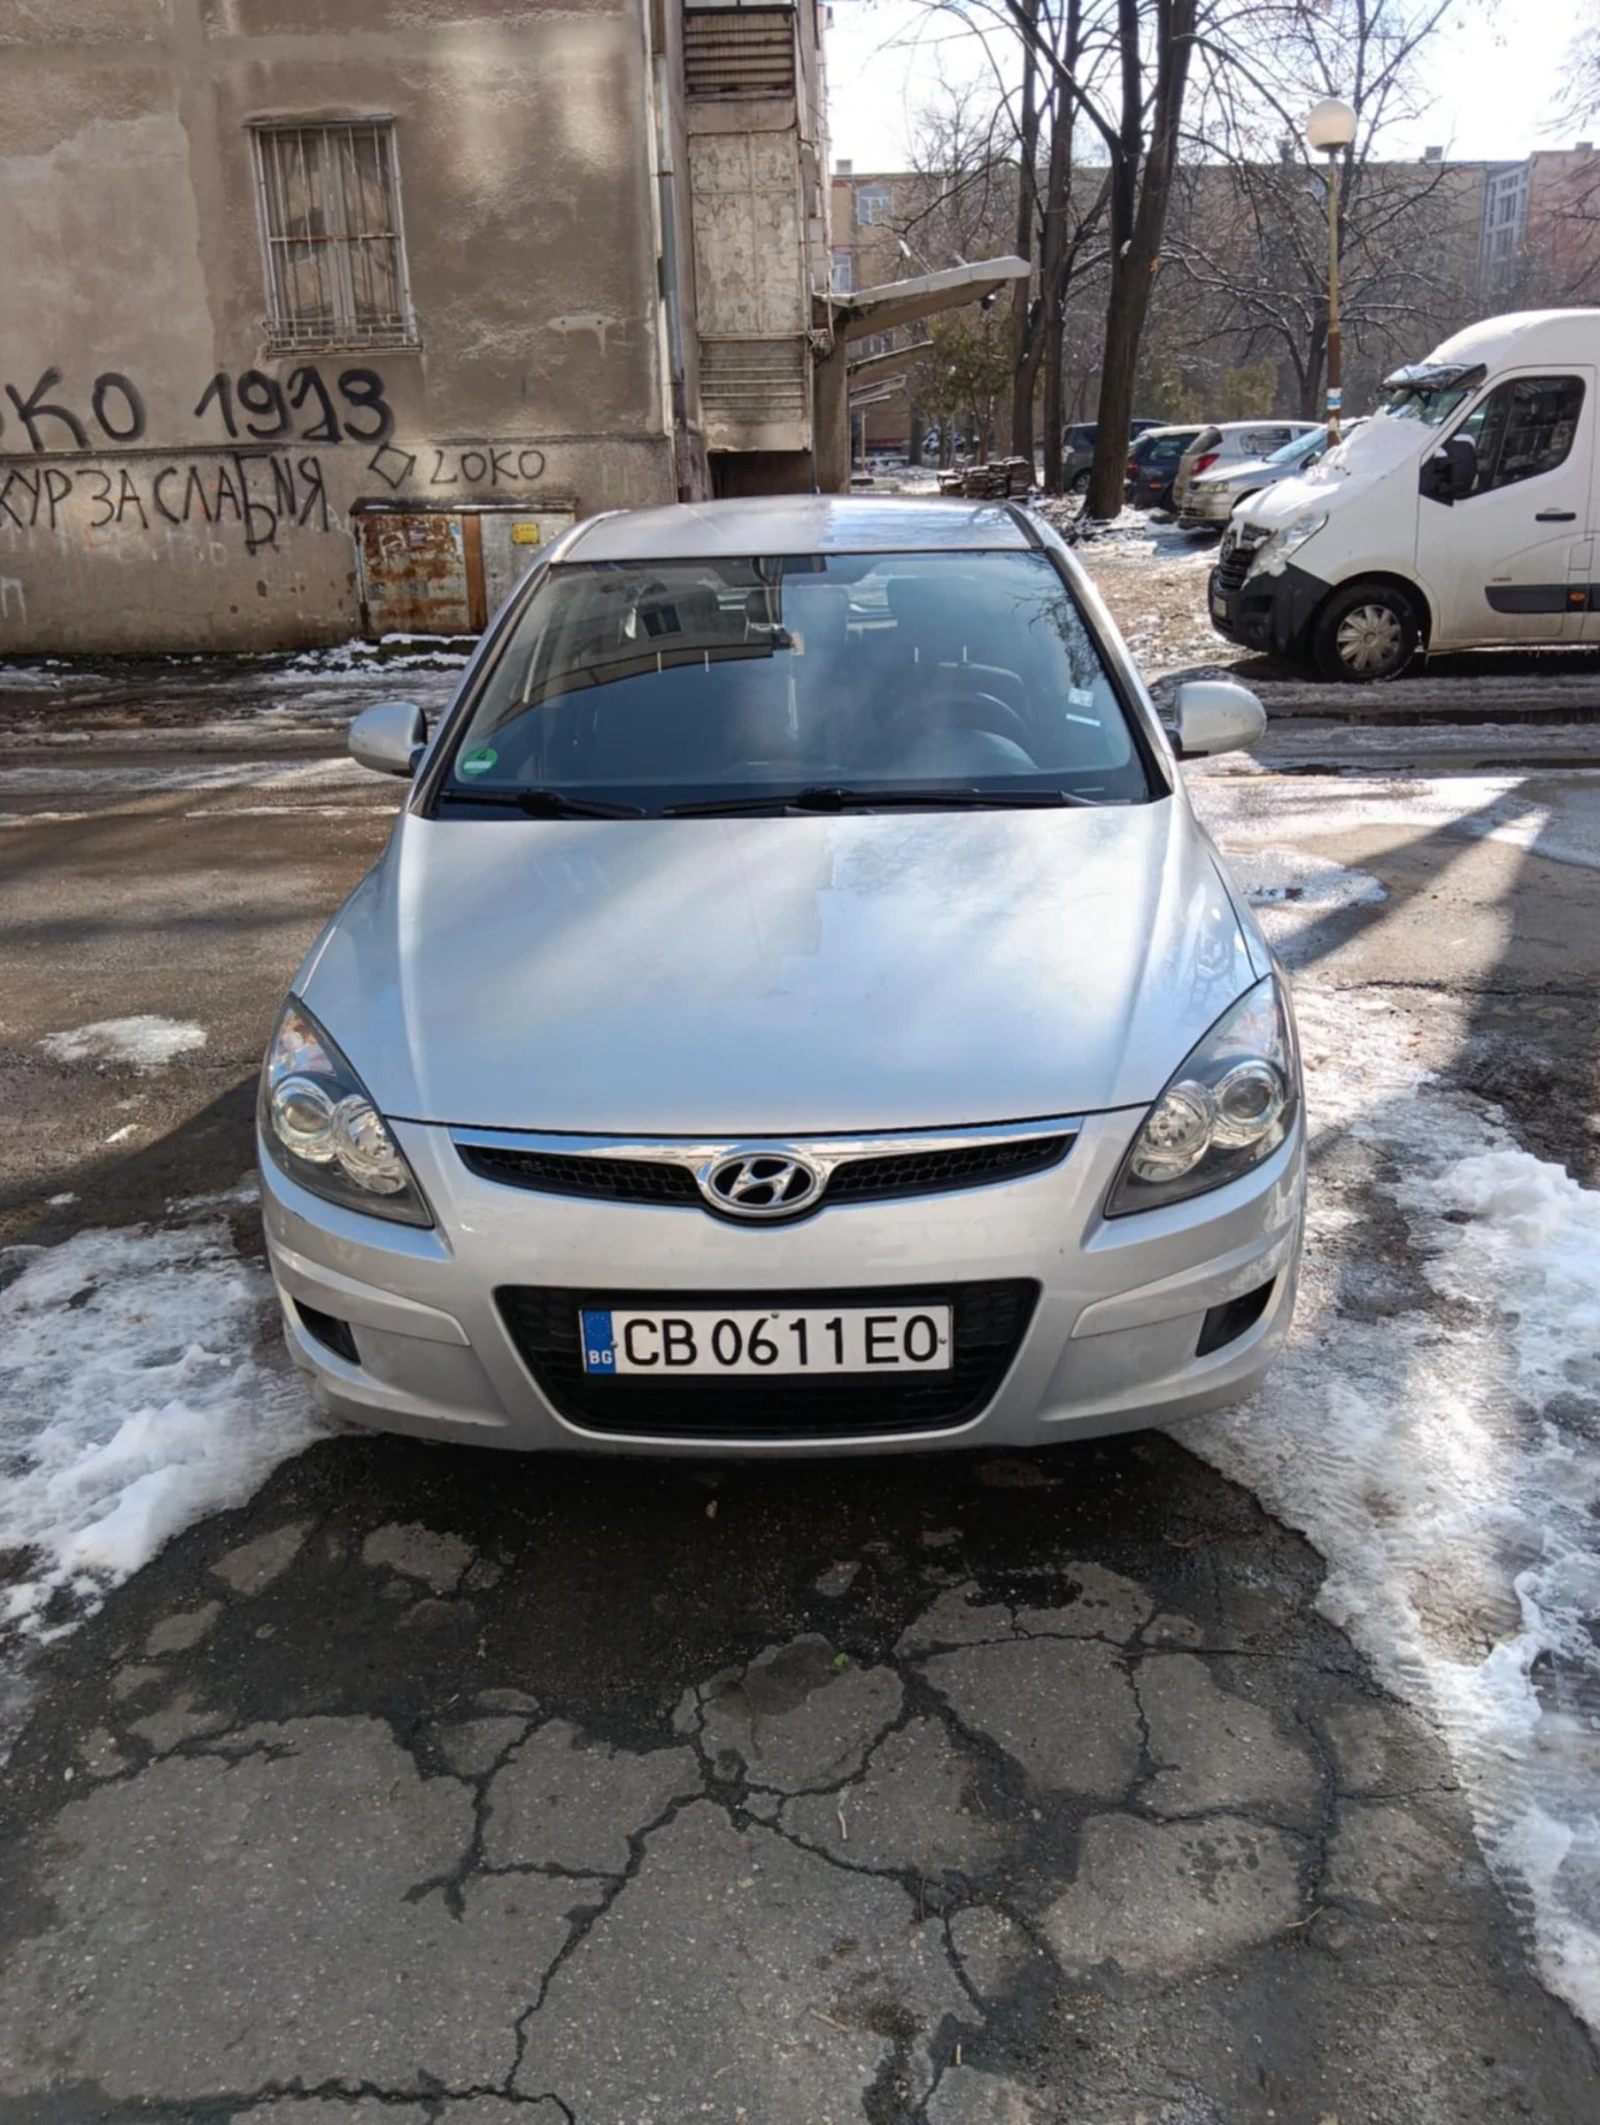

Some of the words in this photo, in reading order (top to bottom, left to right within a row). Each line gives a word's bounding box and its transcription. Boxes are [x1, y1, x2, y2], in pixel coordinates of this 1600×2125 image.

[0, 366, 147, 453] KO
[430, 448, 545, 486] LOKO
[588, 1349, 613, 1365] BG
